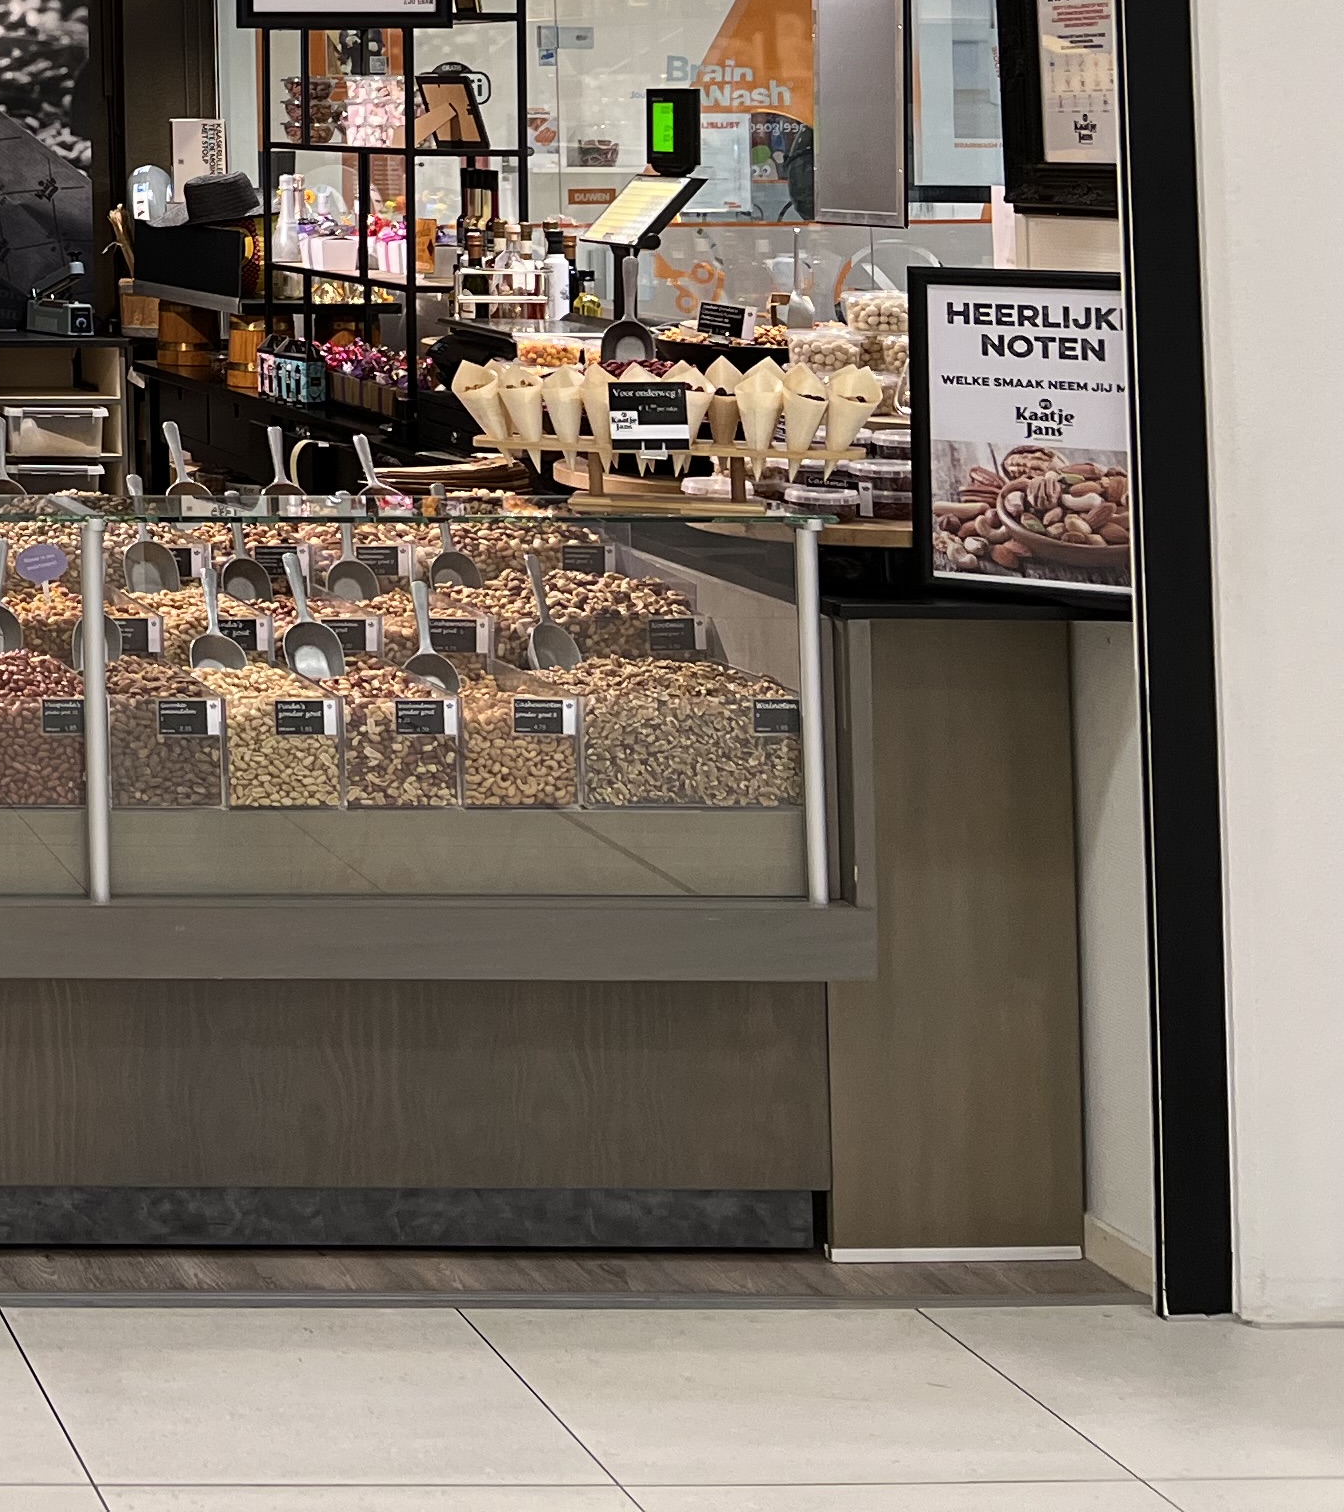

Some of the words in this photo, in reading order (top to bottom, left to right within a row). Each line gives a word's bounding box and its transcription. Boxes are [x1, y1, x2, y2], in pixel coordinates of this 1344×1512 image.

[666, 55, 754, 83] Brain
[699, 79, 792, 107] Wash
[574, 193, 610, 201] DUWEN
[946, 302, 1123, 331] HEERLIJK
[981, 333, 1106, 362] NOTEN
[612, 388, 634, 397] Voor
[941, 374, 990, 387] WELKE
[993, 377, 1045, 390] SMAAK
[1048, 380, 1088, 392] NEEM
[1091, 383, 1112, 393] JIJ
[1015, 406, 1075, 426] Kaatje
[1024, 422, 1063, 438] Jans
